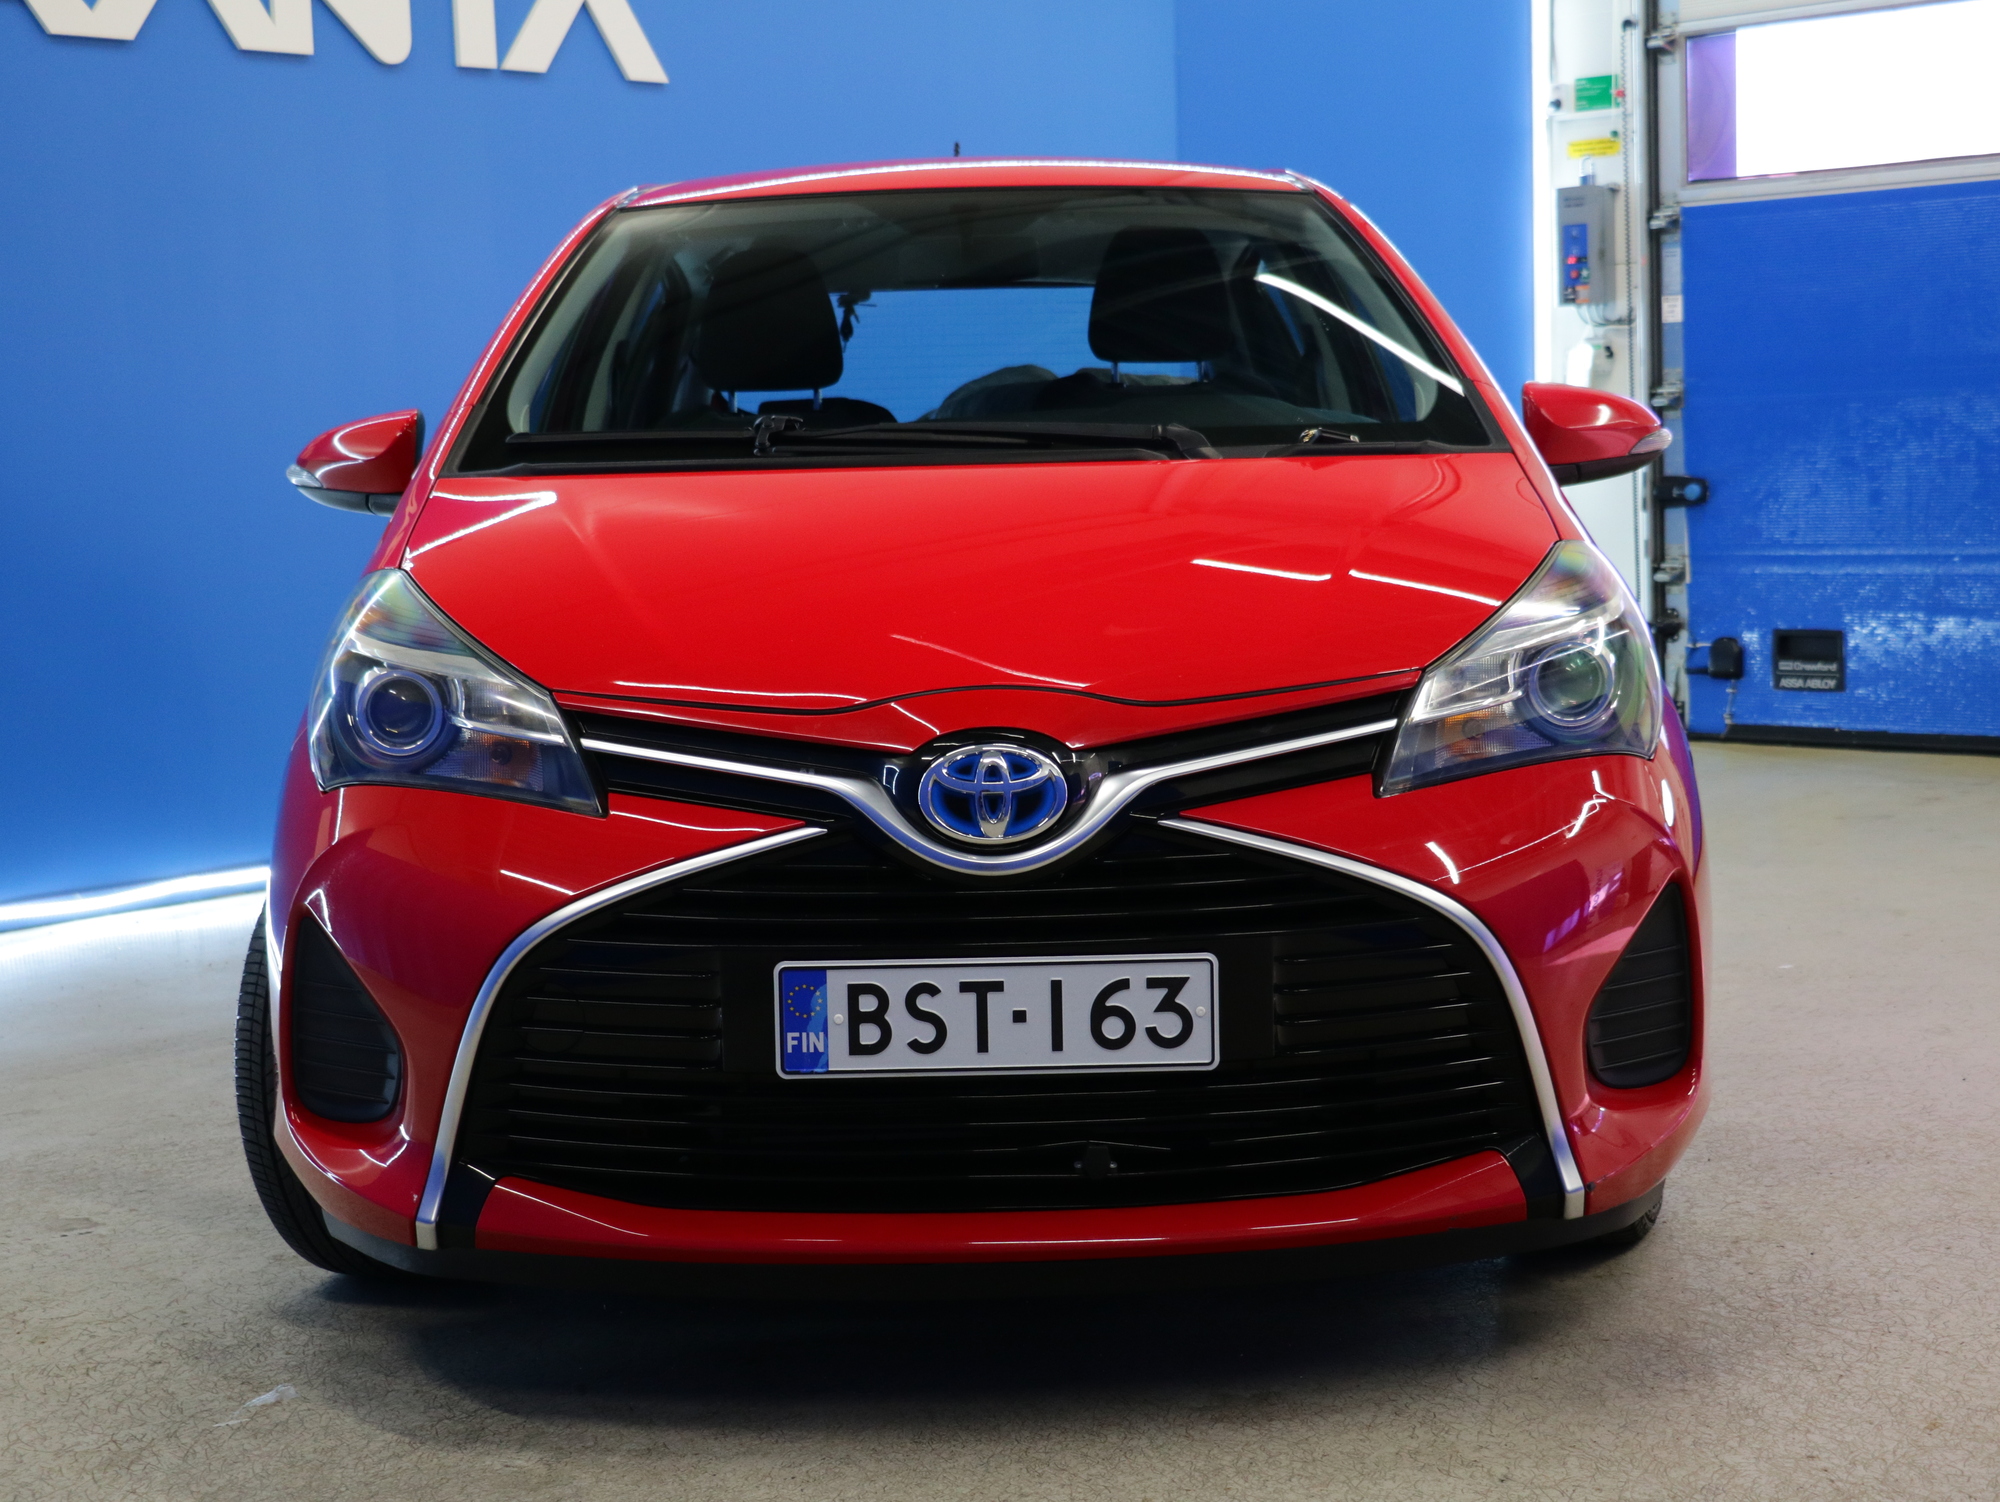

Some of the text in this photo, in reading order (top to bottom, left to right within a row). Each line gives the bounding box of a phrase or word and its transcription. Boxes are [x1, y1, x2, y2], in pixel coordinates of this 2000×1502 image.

[1779, 677, 1837, 689] ASSA ABLOY
[786, 1031, 825, 1054] FIN
